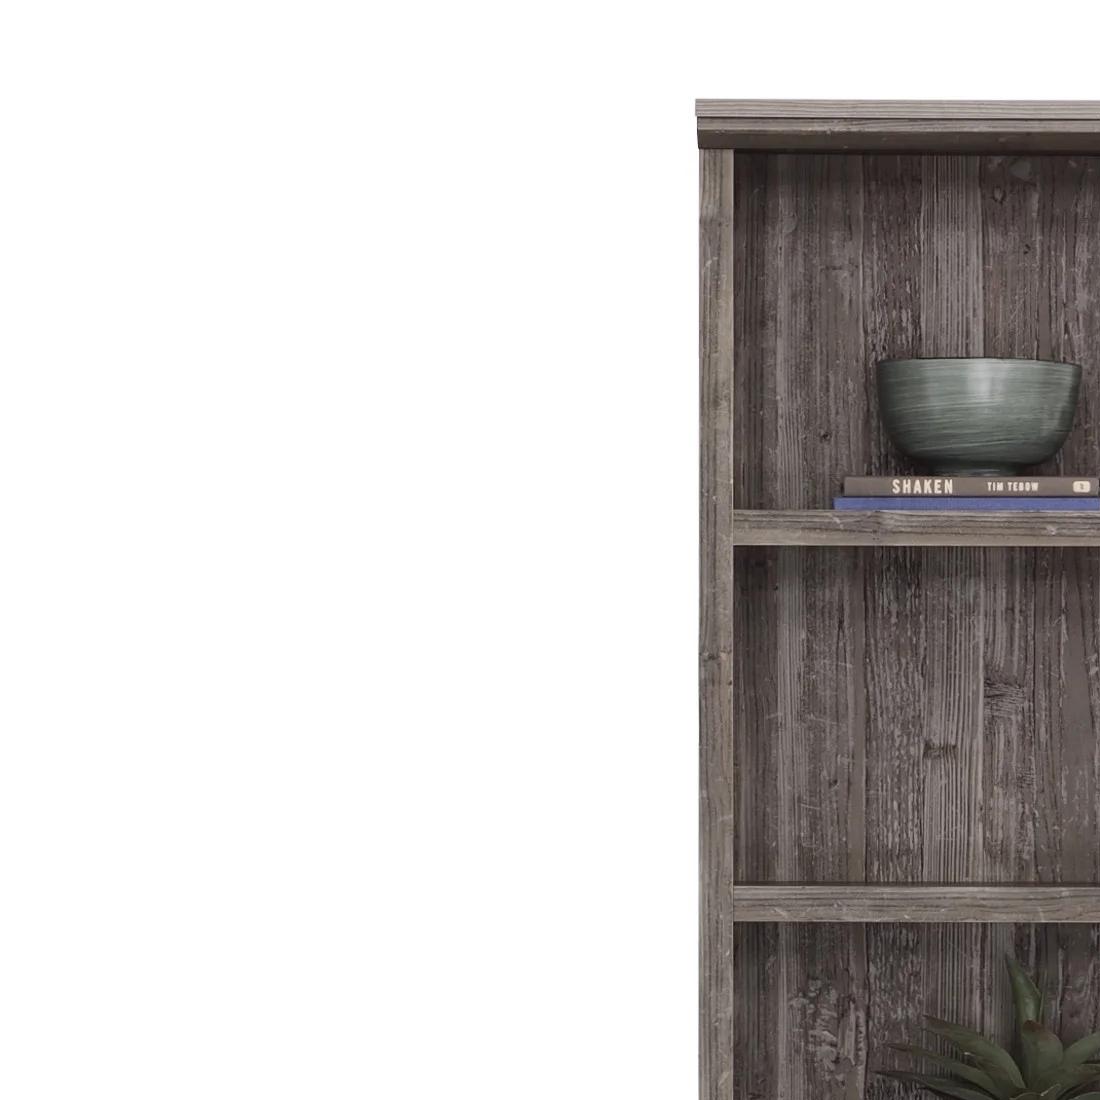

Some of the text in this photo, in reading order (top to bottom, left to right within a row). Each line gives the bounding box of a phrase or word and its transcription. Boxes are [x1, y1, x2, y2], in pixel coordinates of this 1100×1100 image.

[892, 479, 1039, 494] SHAKEN TIM TEBOW
